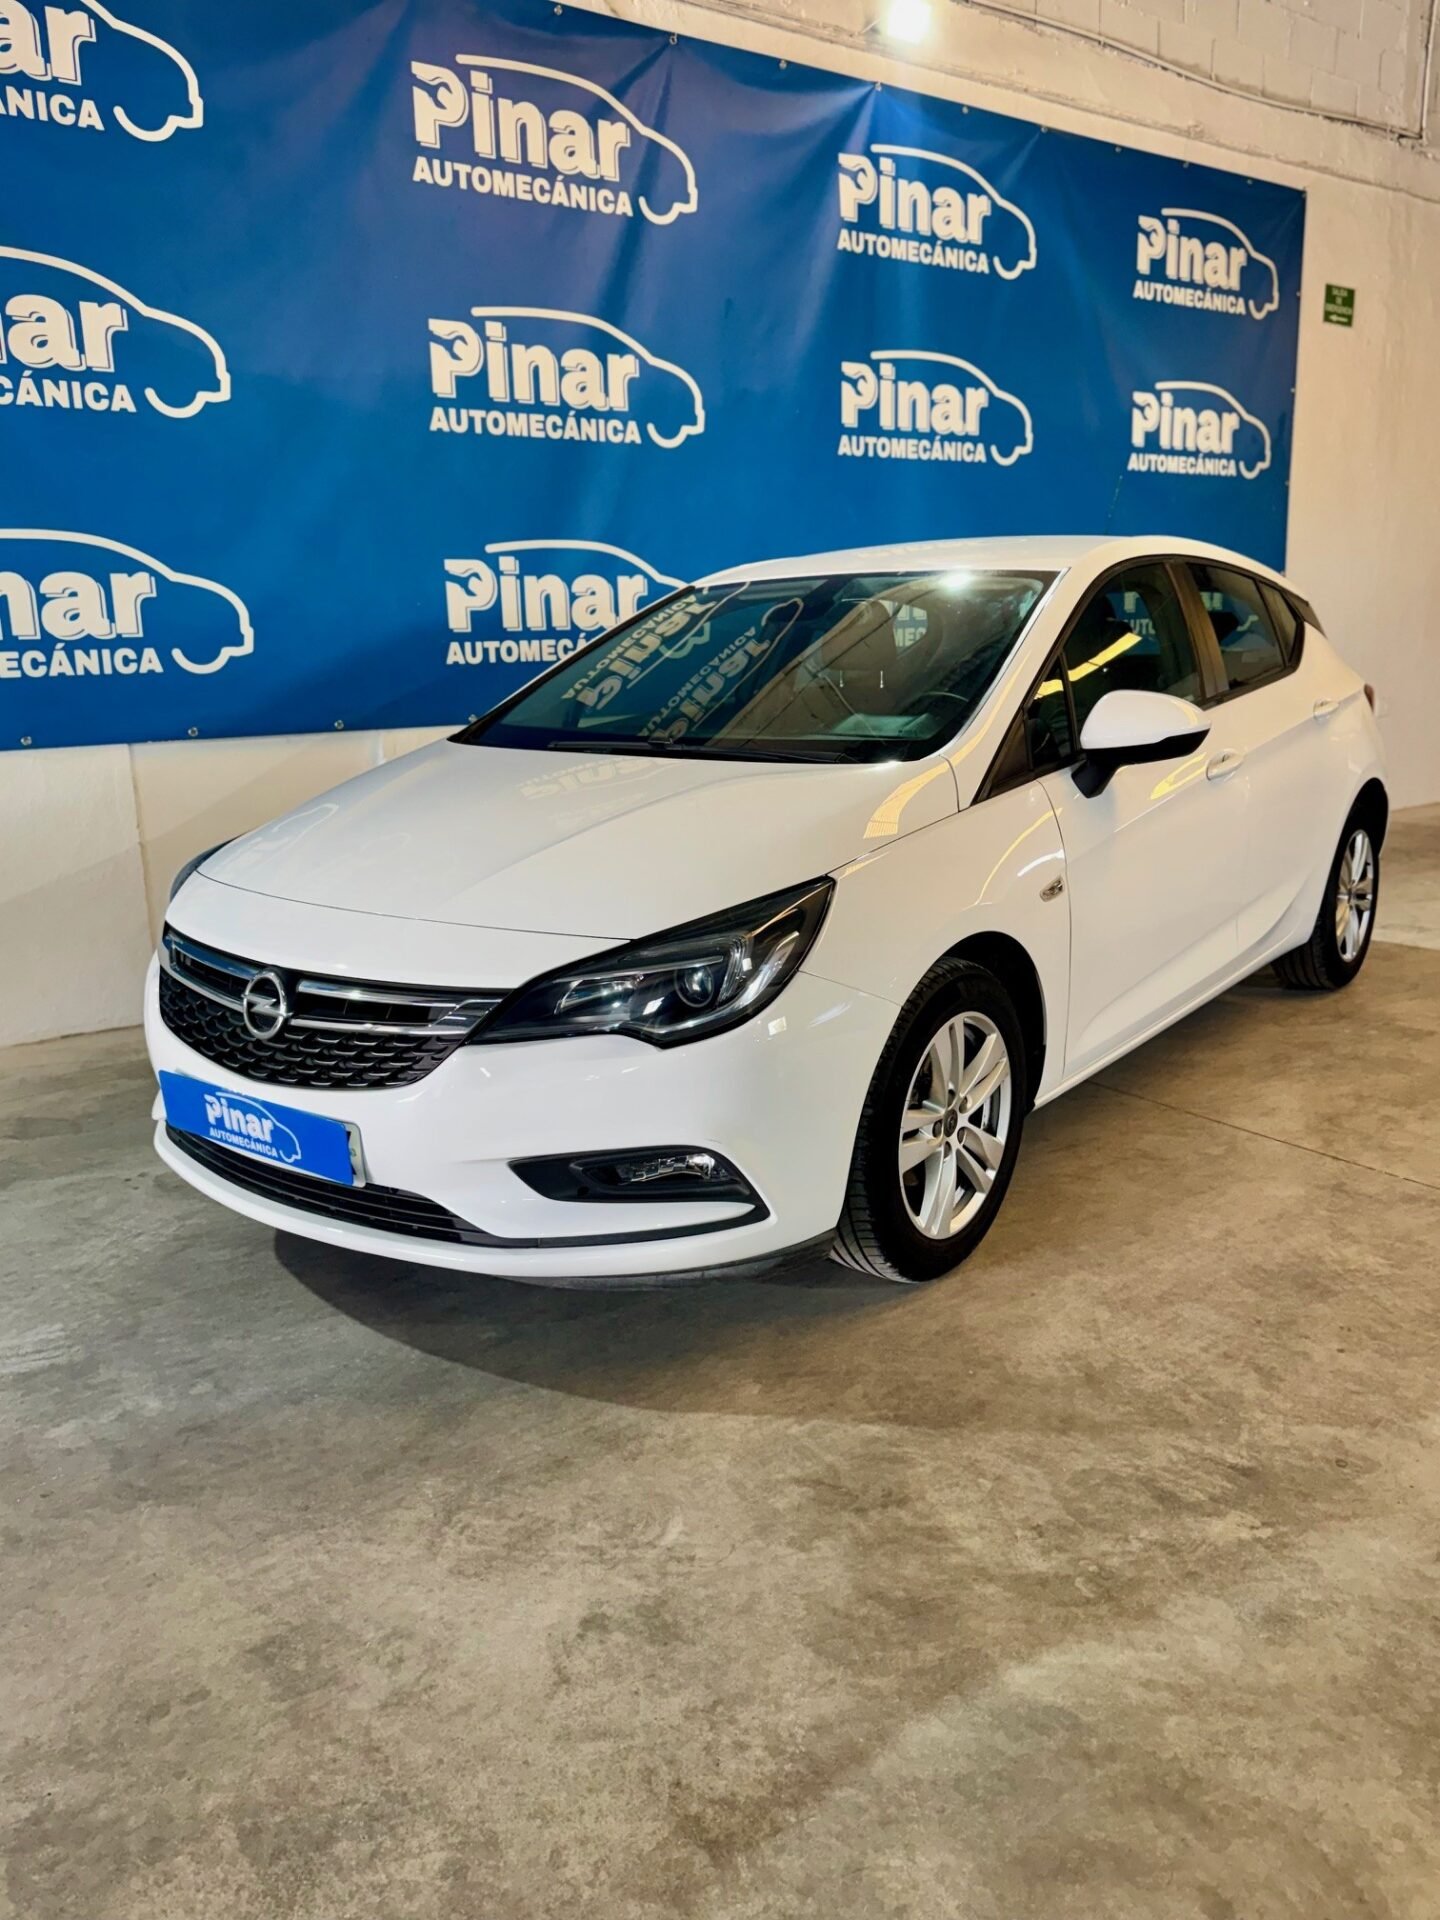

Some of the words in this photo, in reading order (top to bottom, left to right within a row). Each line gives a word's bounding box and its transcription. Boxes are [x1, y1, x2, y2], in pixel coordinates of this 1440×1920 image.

[0, 85, 105, 131] NICA
[411, 61, 631, 182] Pinar
[413, 157, 633, 216] AUTOMECÁNICA
[838, 153, 991, 244] Pinar
[836, 229, 990, 274] AUTOMECÁNICA
[1136, 215, 1247, 291] Pinar
[1133, 280, 1246, 315] AUTOMECÁNICA
[0, 294, 129, 373] ar
[428, 318, 639, 412] Pinar
[430, 406, 641, 444] AUTOMECÁNICA
[841, 361, 989, 436] Pinar
[1131, 391, 1239, 454] Pinar
[837, 434, 987, 463] AUTOMECÁNICA
[1127, 453, 1237, 477] AUTOMECÁNICA
[443, 556, 649, 633] Pinar
[203, 1094, 275, 1143] Pinar
[209, 1128, 279, 1158] AUTOMECÁNICA
